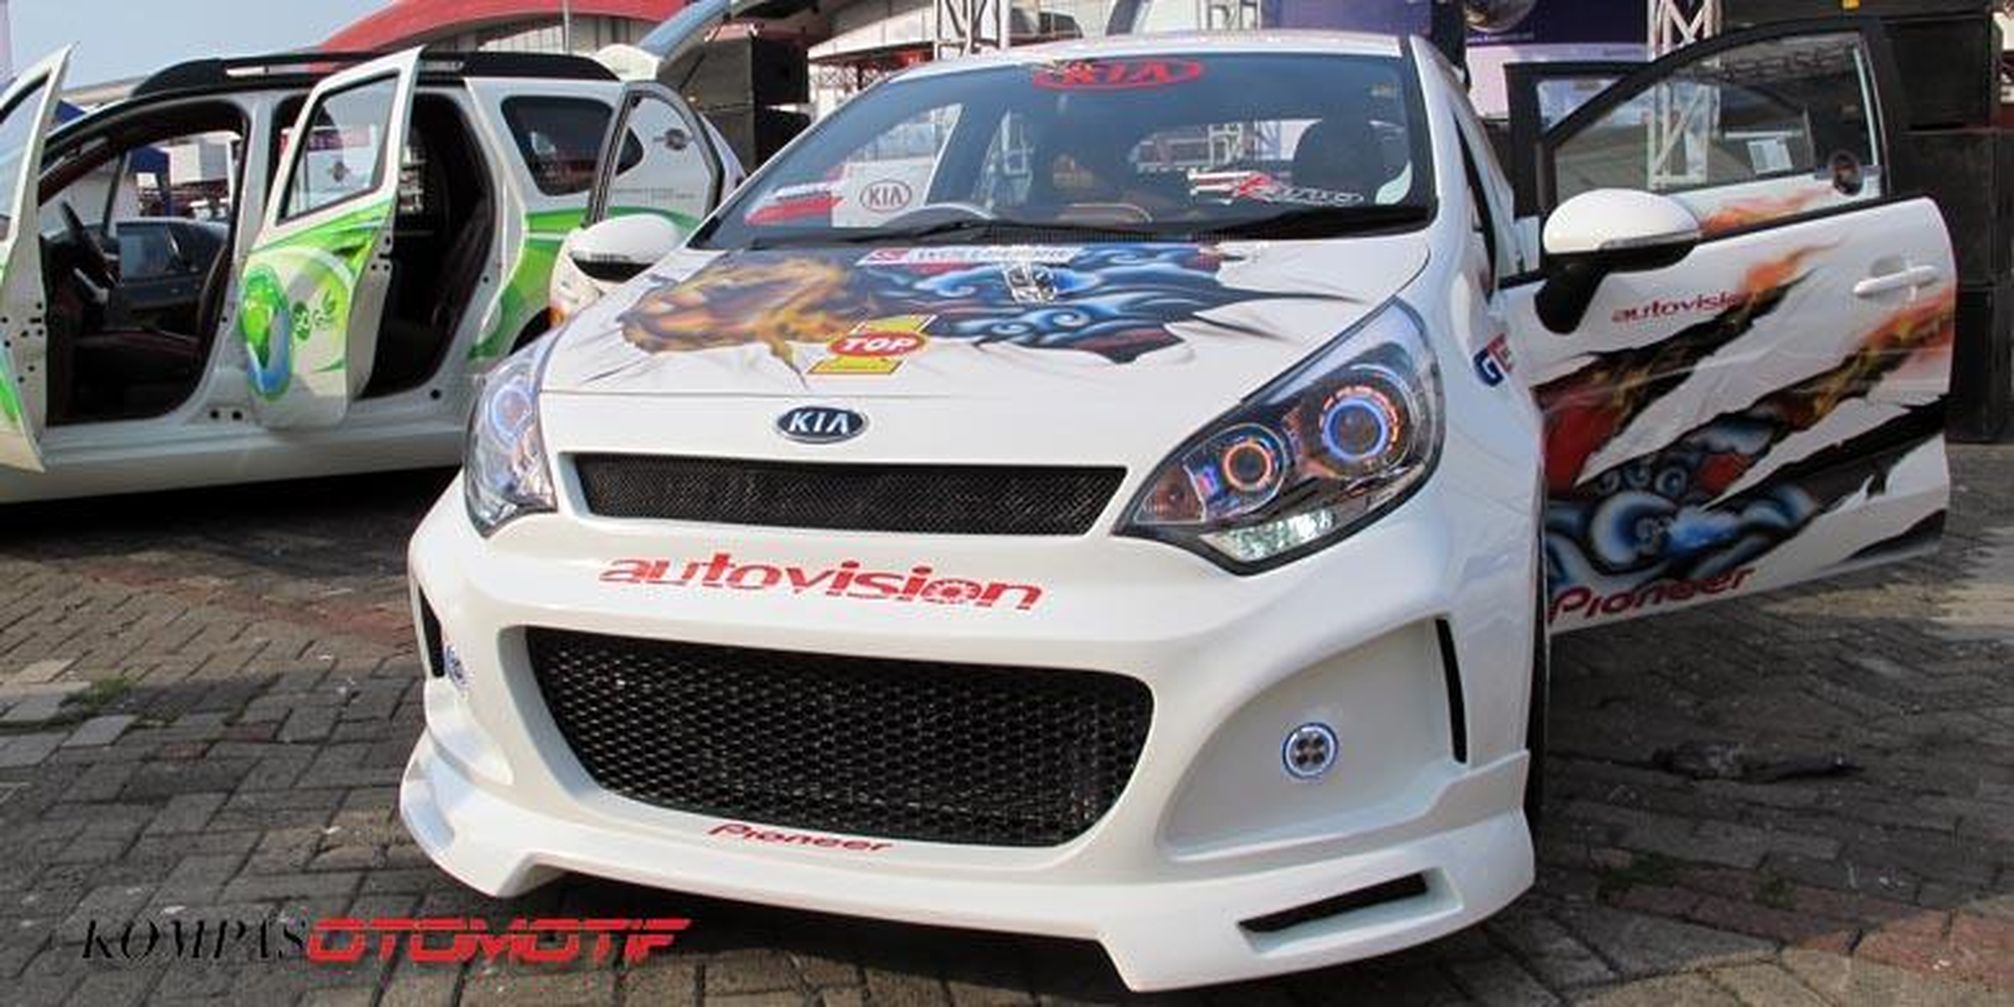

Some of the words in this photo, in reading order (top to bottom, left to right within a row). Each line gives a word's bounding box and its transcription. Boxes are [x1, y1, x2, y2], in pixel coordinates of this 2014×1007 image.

[1064, 60, 1171, 84] KIA
[868, 184, 902, 206] KIA
[843, 336, 917, 352] TOP
[788, 411, 850, 434] KIA
[599, 552, 1042, 611] autovision
[1547, 567, 1755, 624] Pioneer
[708, 823, 893, 851] Pioneer
